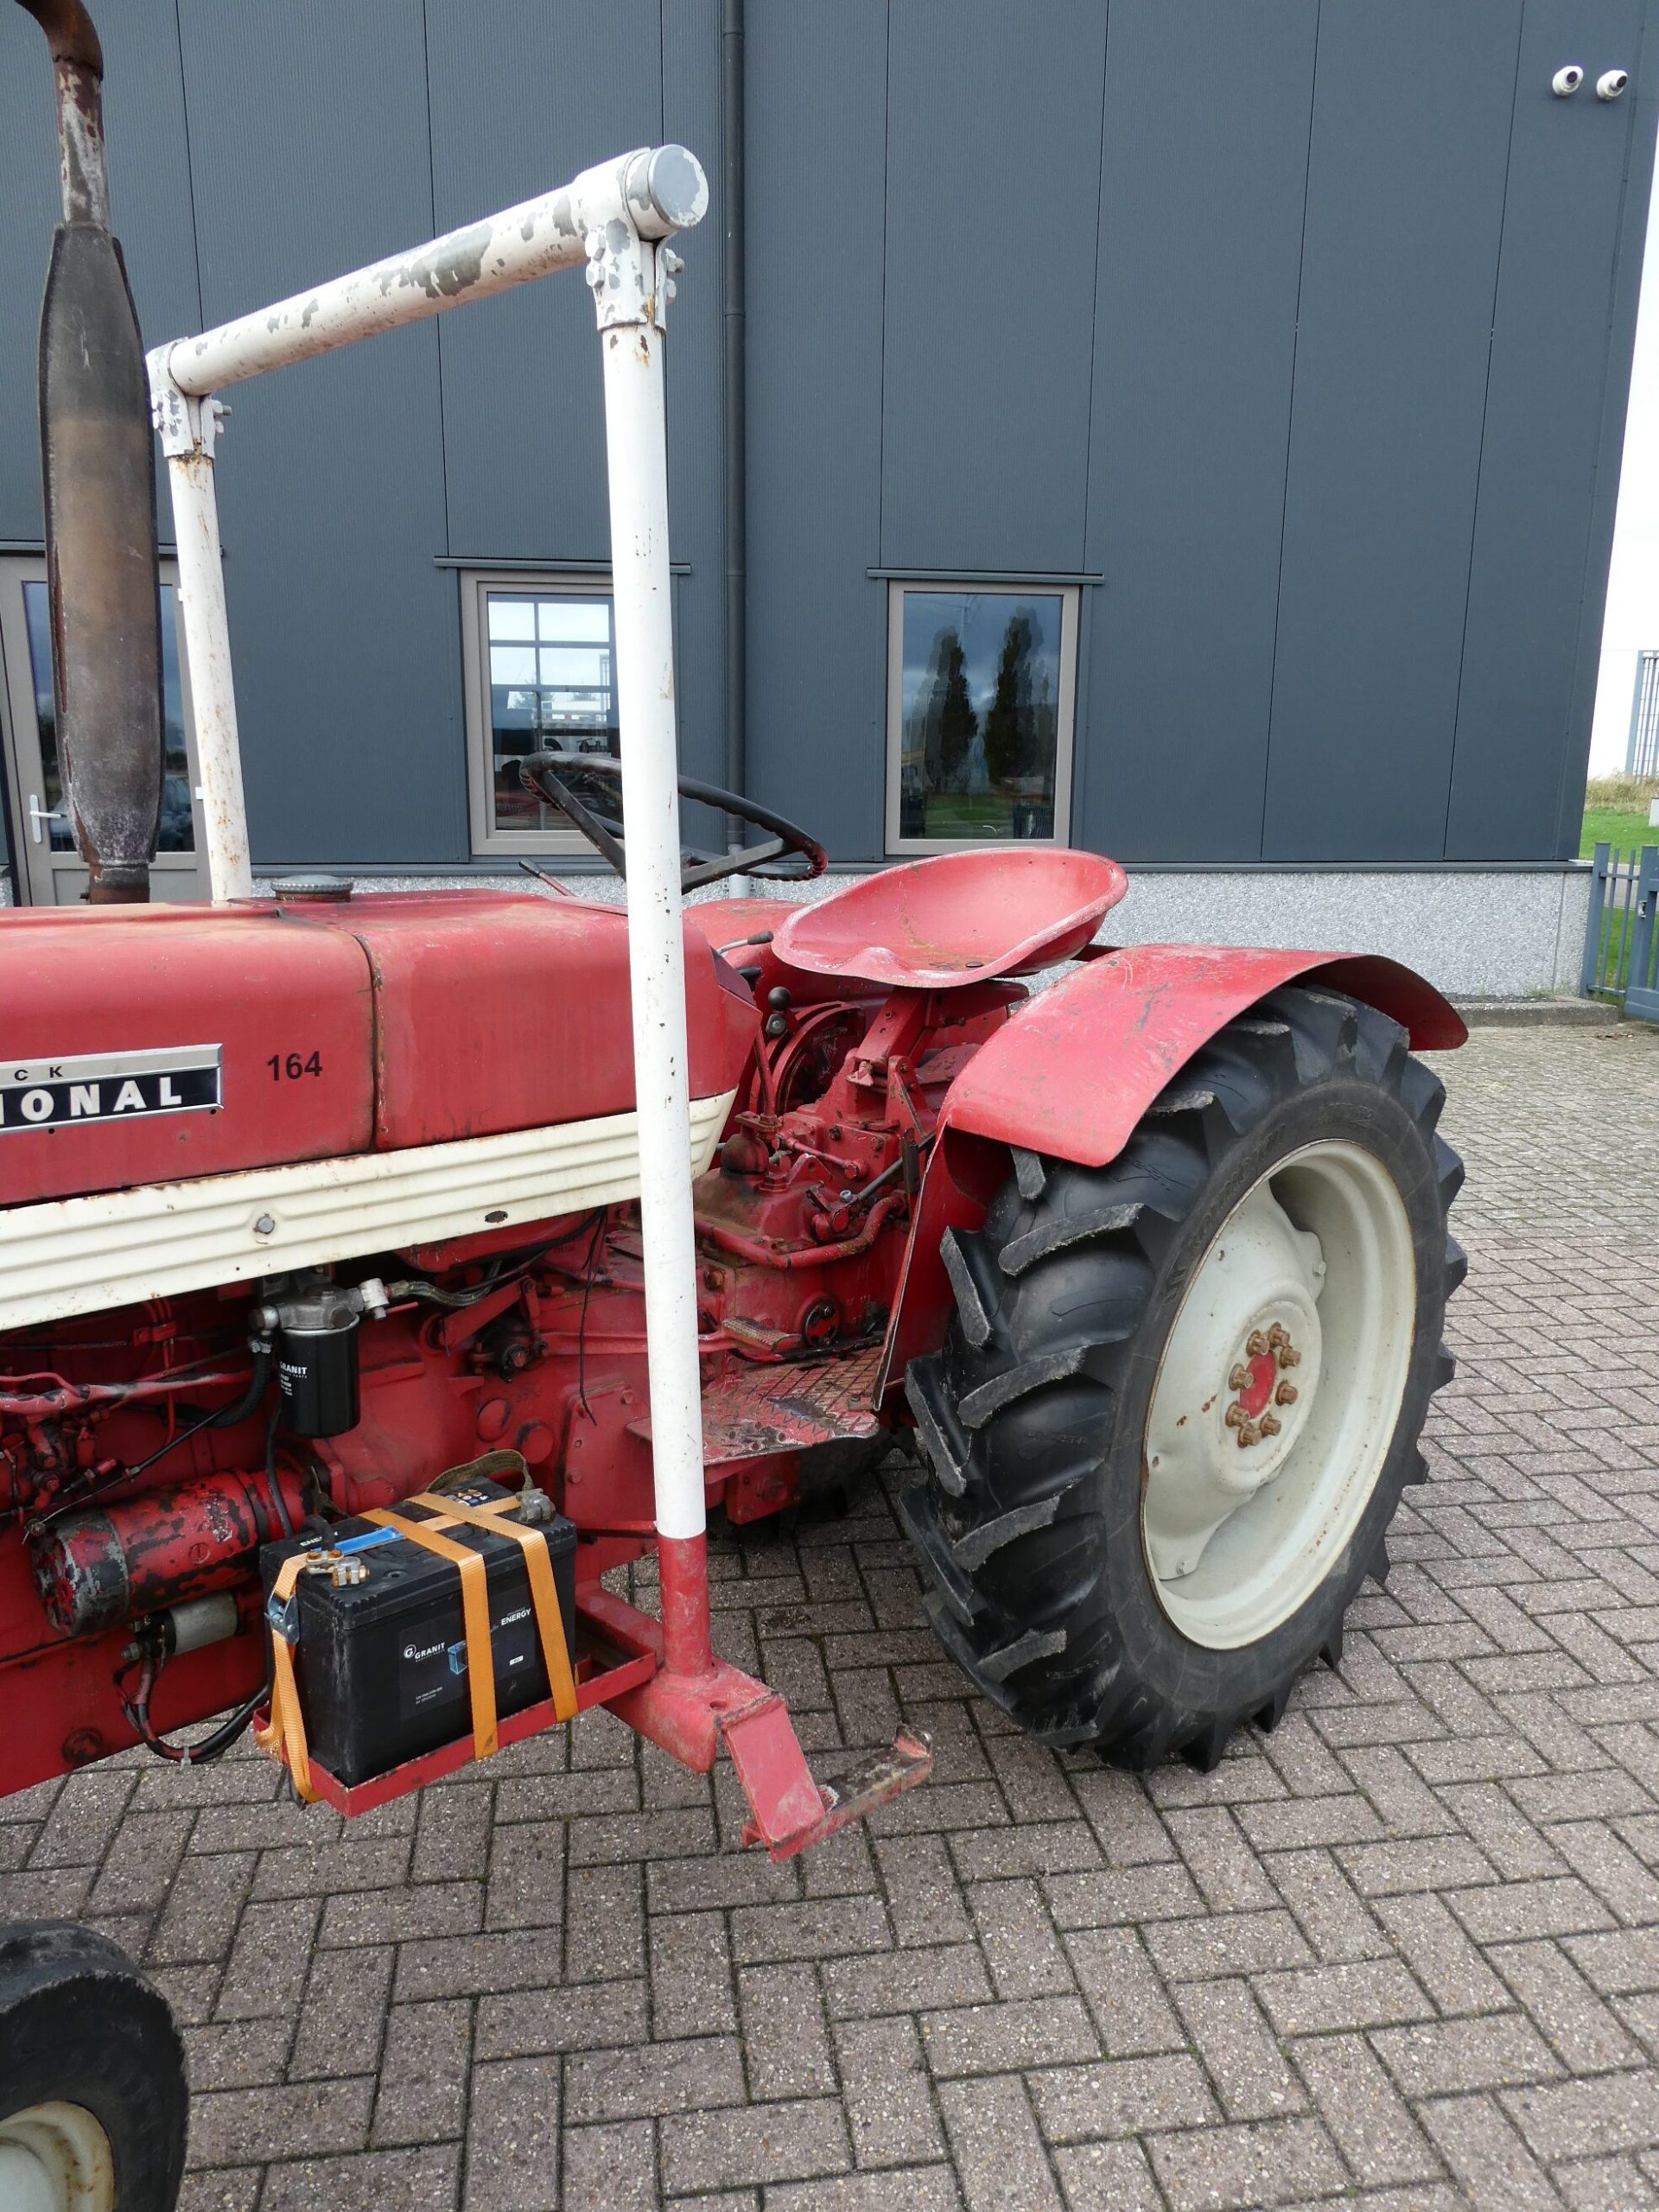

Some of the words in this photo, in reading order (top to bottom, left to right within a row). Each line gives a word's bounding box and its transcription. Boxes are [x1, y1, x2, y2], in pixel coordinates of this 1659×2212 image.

[267, 1050, 323, 1082] 164
[501, 1607, 531, 1625] ENERGY
[415, 1642, 446, 1659] GRANIT
